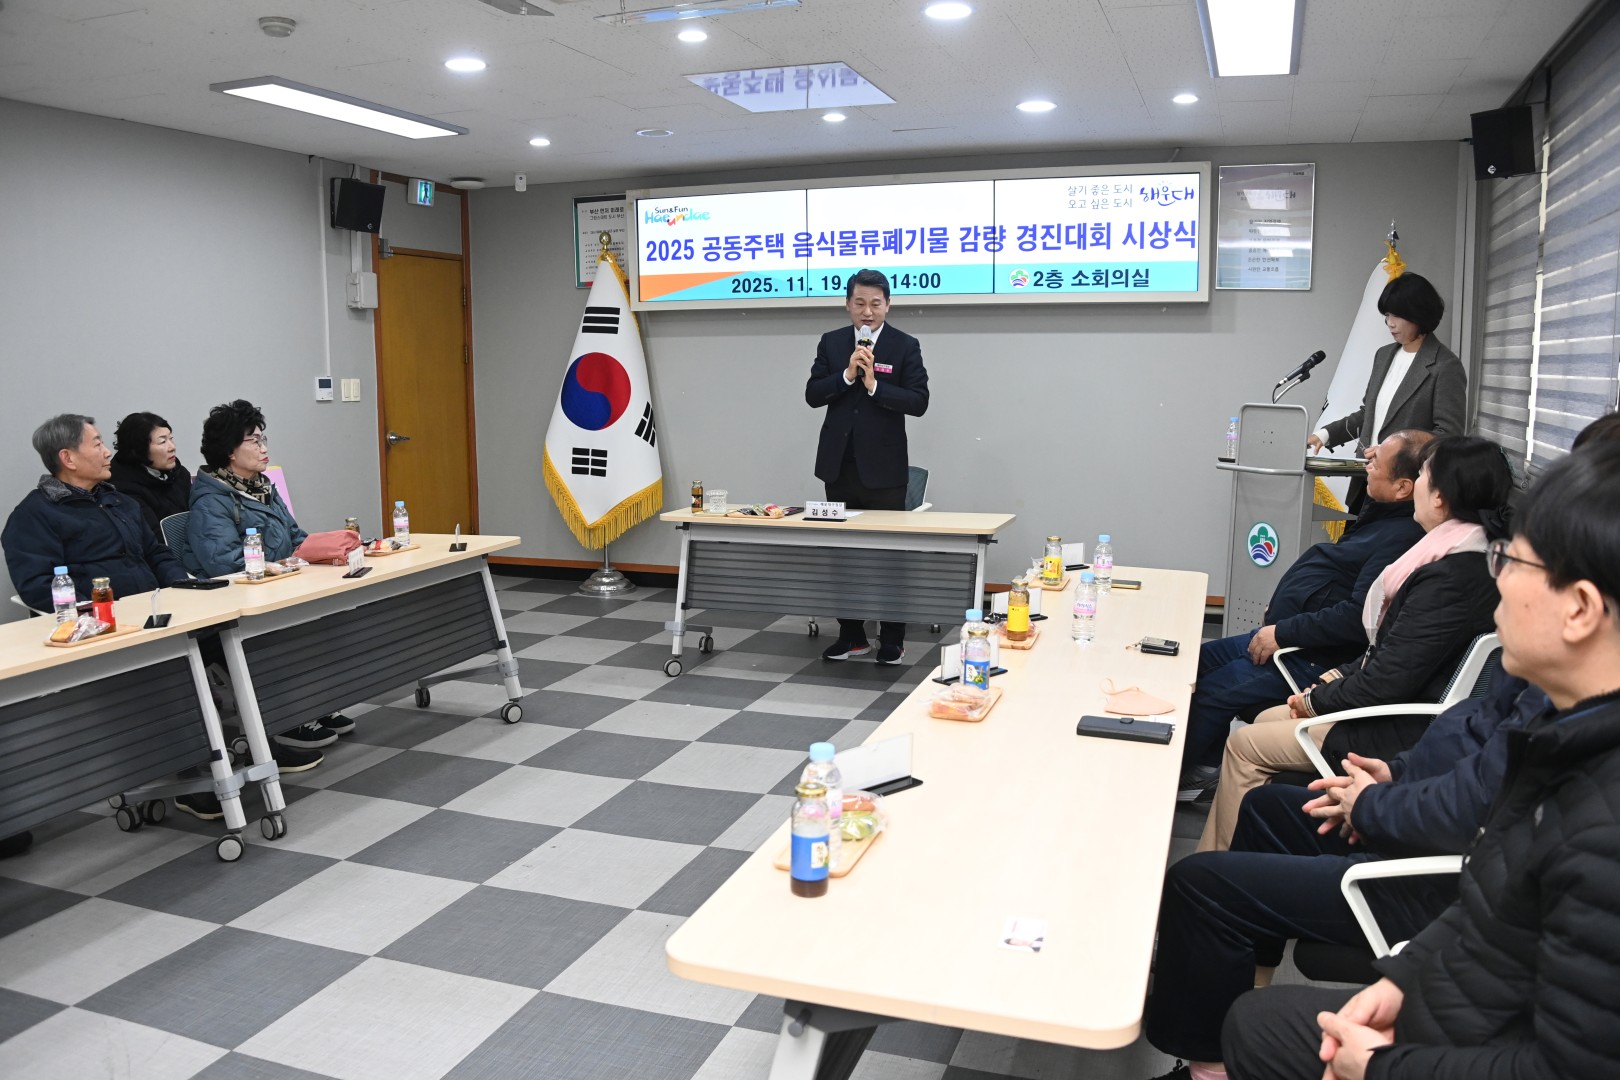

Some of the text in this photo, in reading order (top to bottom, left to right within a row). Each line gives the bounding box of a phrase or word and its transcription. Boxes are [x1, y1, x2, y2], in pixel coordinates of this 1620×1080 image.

[1067, 183, 1134, 196] 살기 좋은 도시
[1139, 181, 1195, 206] 해운대
[1067, 197, 1134, 210] 오고 싶은 도시
[645, 220, 1197, 263] 2025 공동주택 음식물류폐기물 감량 경진대회 시상식
[731, 278, 779, 294] 2025.
[786, 276, 813, 292] 11.
[889, 272, 942, 289] 14:00
[1033, 267, 1150, 289] 2층 소회의실
